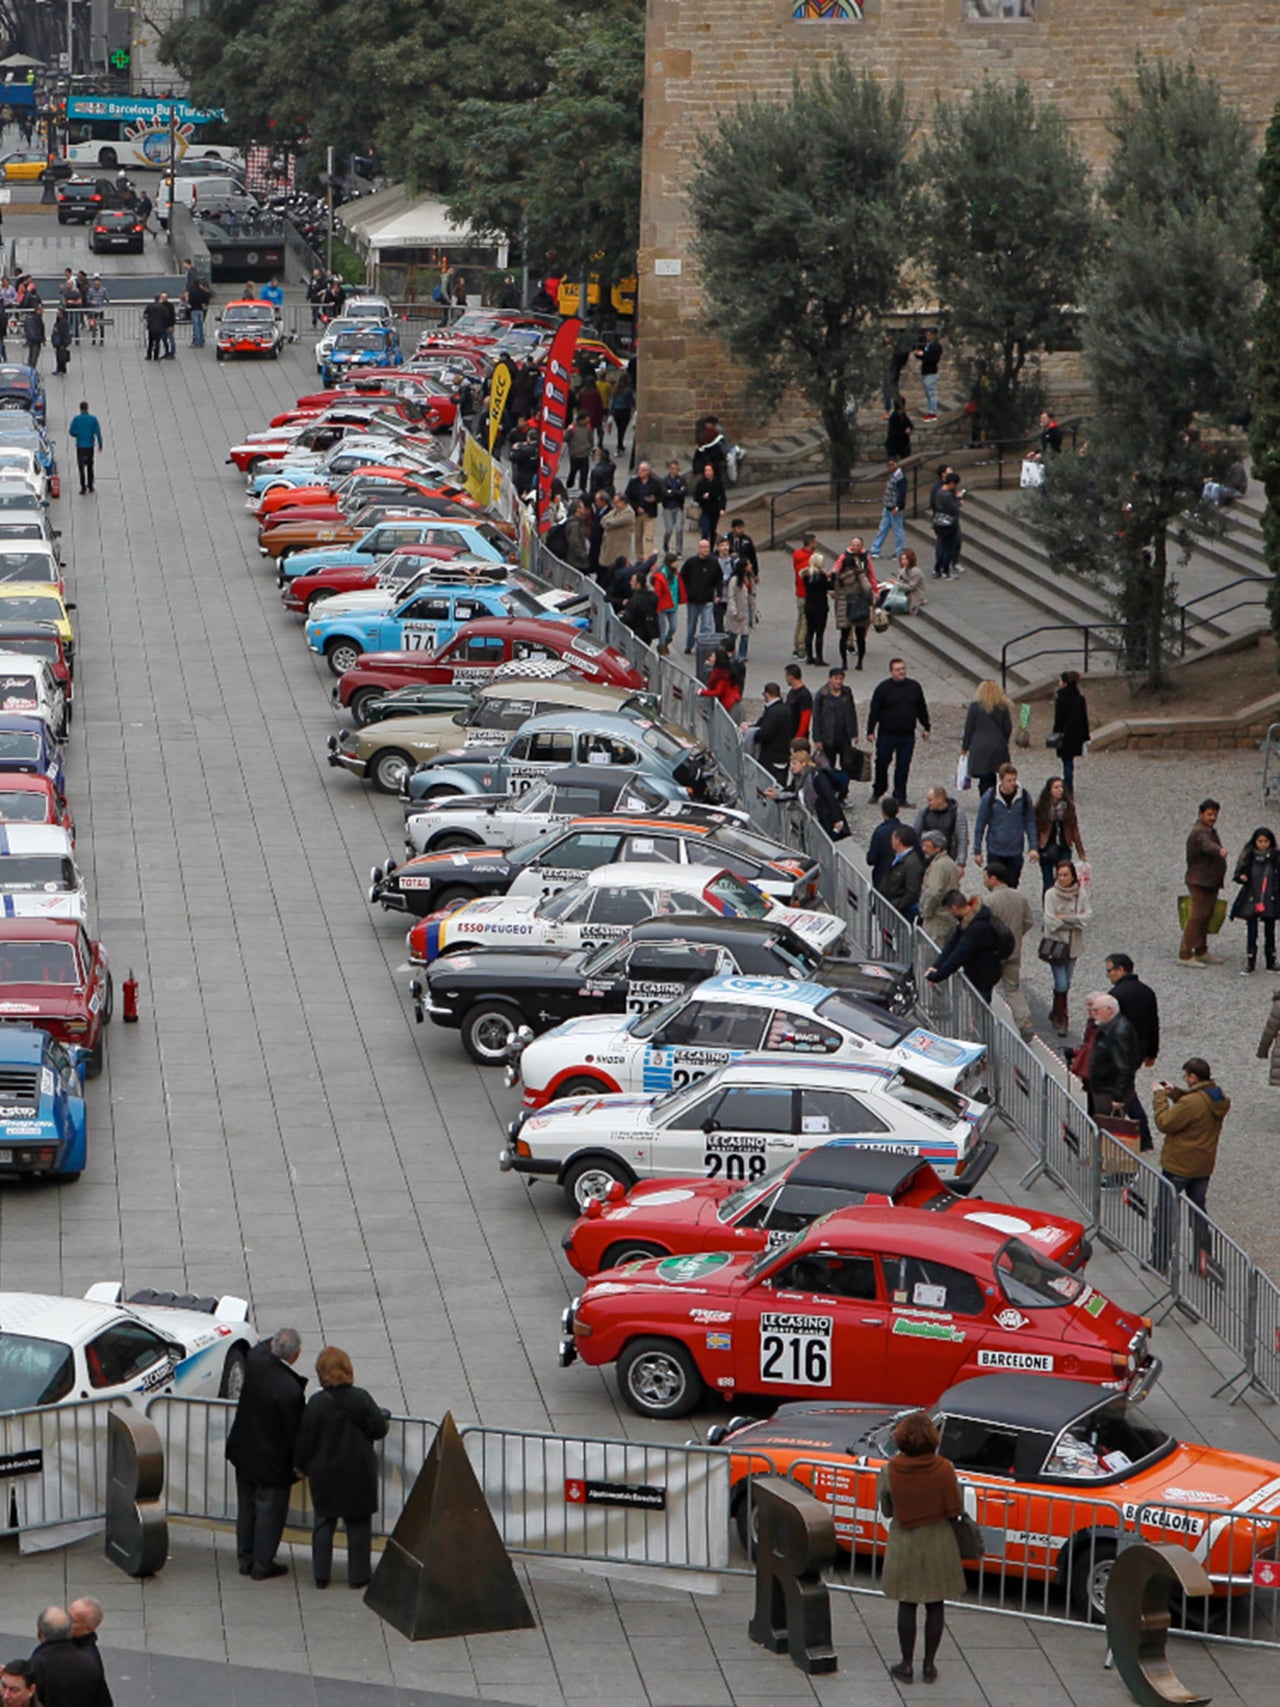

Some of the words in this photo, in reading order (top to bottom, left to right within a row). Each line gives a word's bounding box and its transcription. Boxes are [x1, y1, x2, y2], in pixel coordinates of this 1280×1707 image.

[109, 104, 153, 115] Barcelona
[492, 375, 506, 420] RACC
[404, 634, 433, 651] 174
[400, 878, 429, 888] TOTAL
[721, 1137, 765, 1148] CASINO
[705, 1154, 766, 1181] 208
[764, 1314, 778, 1326] LE
[780, 1315, 829, 1329] CASINO
[763, 1336, 827, 1382] 216
[982, 1352, 1049, 1370] BARCELONE
